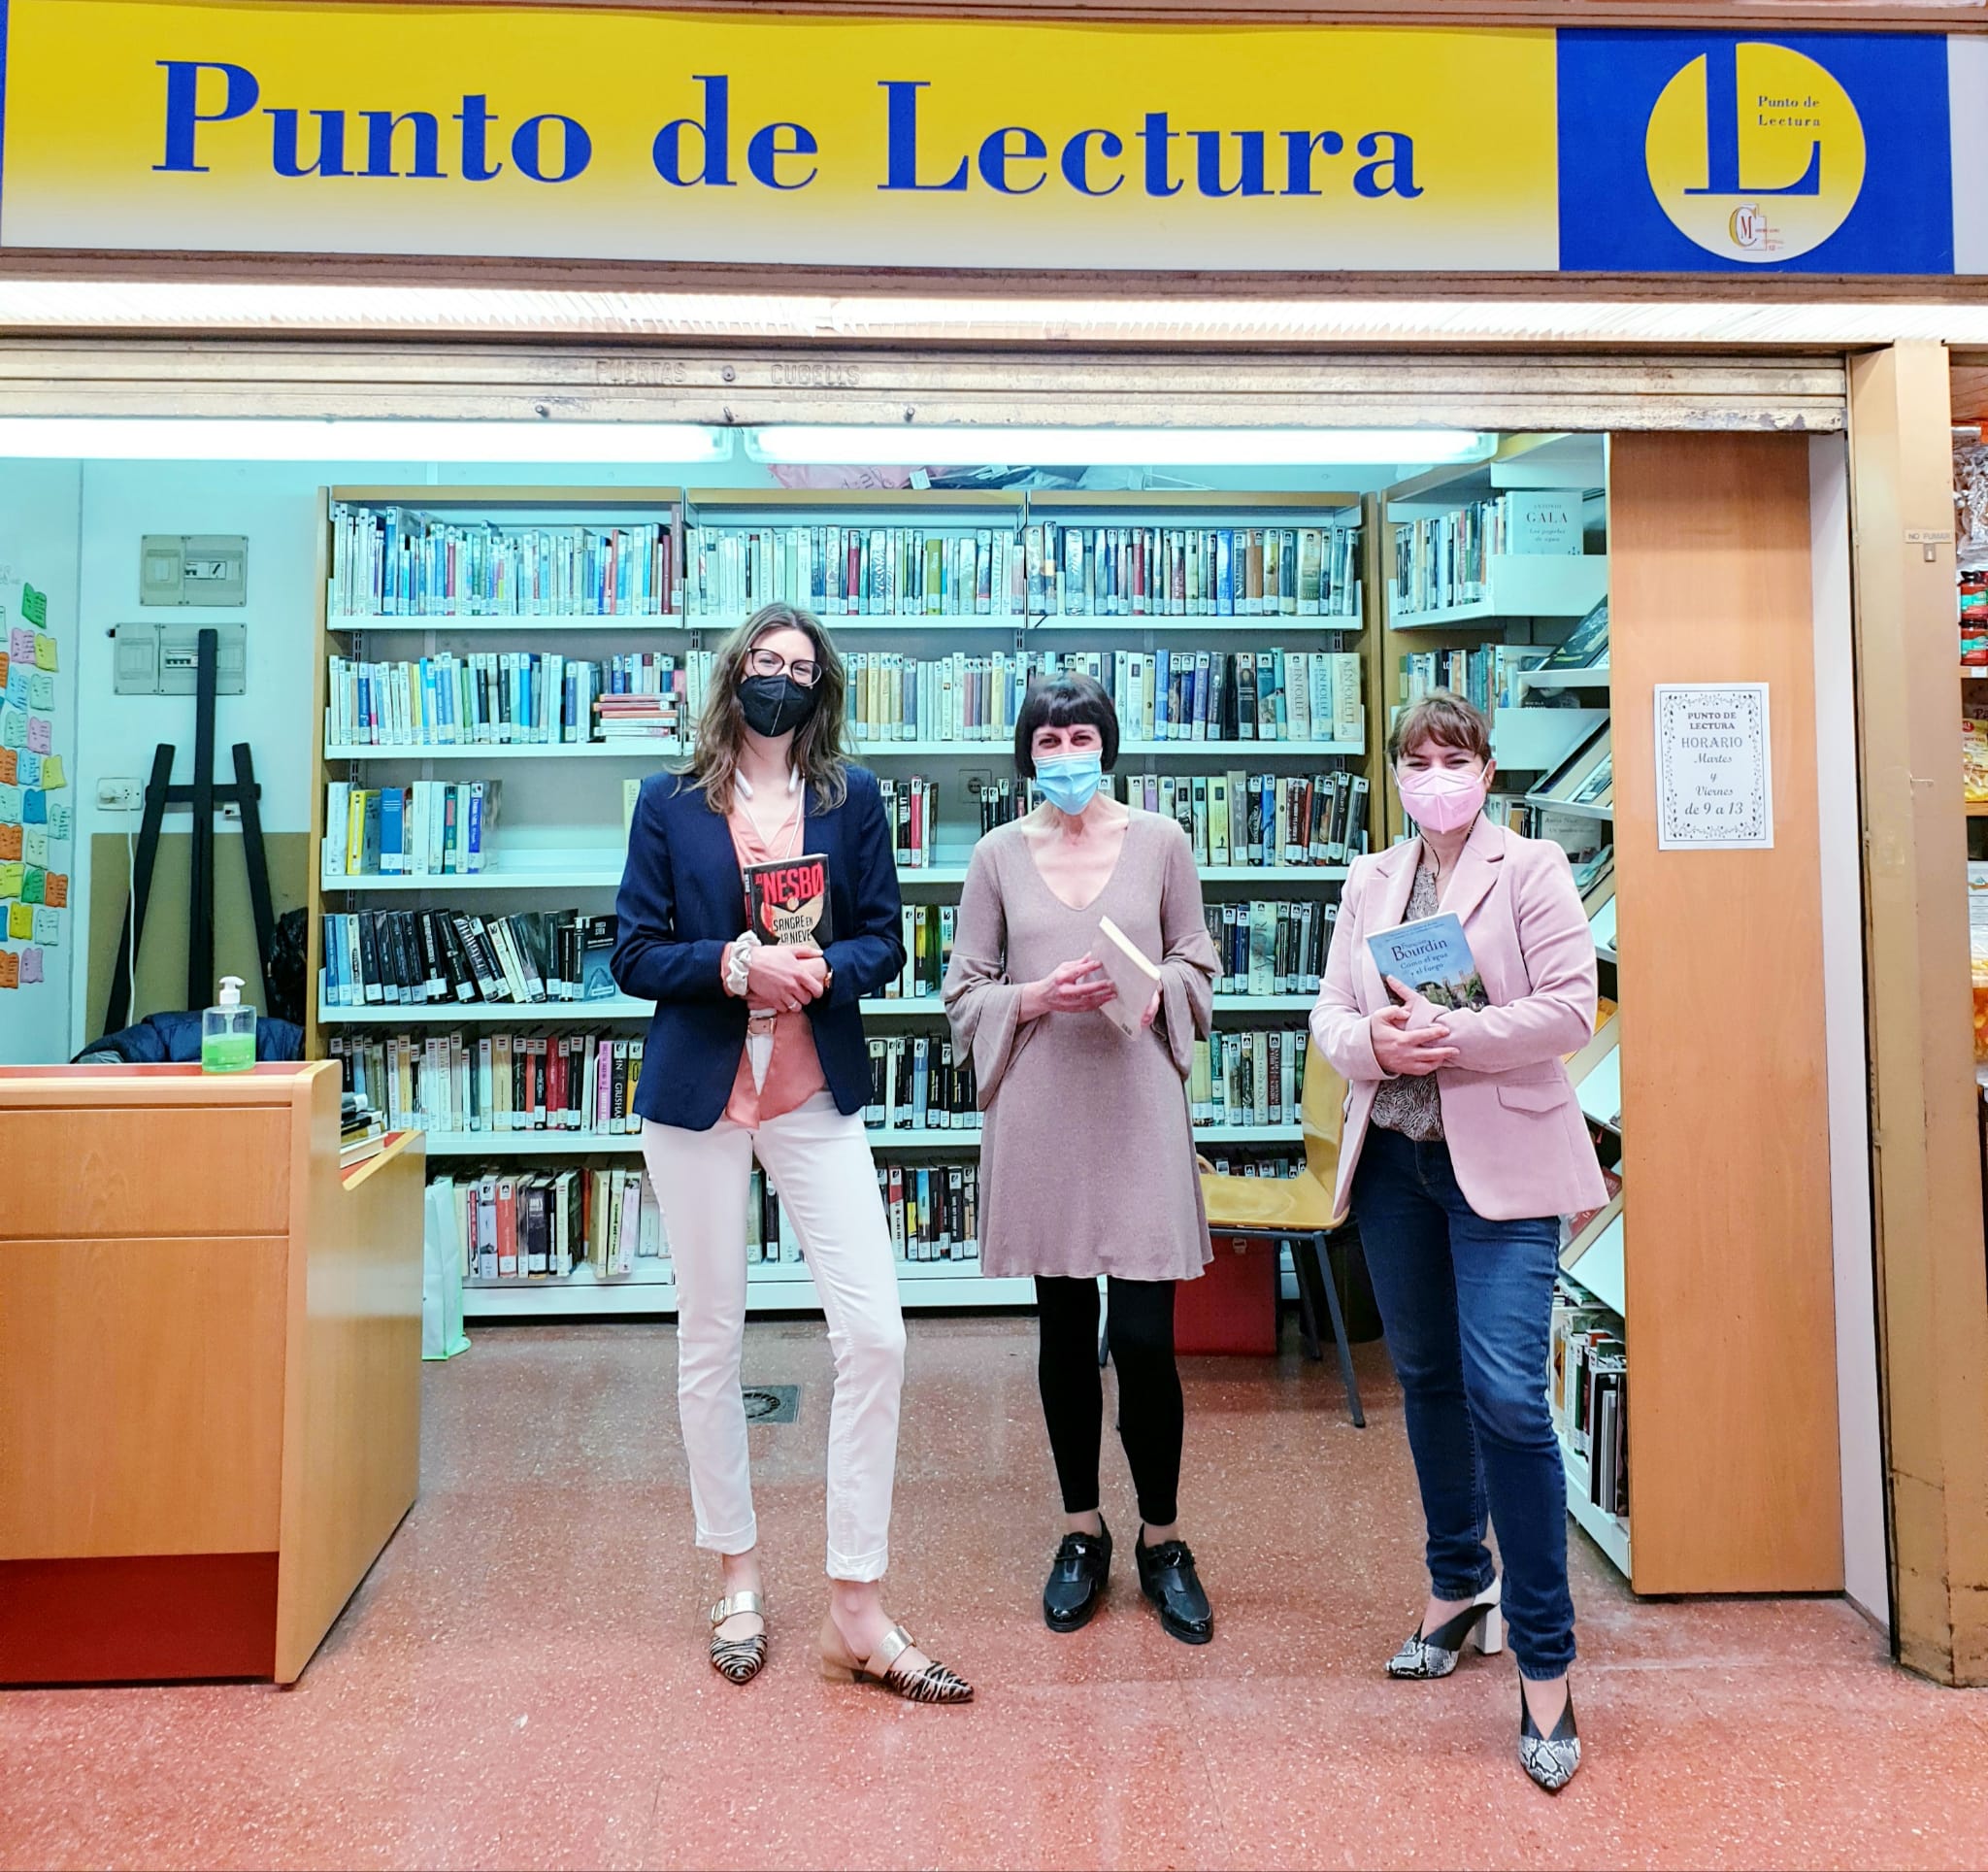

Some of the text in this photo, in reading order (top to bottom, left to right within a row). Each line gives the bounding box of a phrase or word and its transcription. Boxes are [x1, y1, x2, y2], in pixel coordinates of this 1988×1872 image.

[1758, 95, 1821, 108] Punto de
[1758, 115, 1821, 127] Lectura
[151, 59, 1425, 200] Punto de Lectura
[596, 360, 862, 385] PUERTAS CUBELLS
[1526, 512, 1568, 523] GALA
[1688, 712, 1721, 720] PUNTO
[1690, 721, 1736, 730] LECTURA
[1681, 737, 1742, 749] HORARIO
[1694, 752, 1733, 763] Martes
[1710, 772, 1717, 783] y
[1696, 785, 1734, 796] Viernes
[1684, 801, 1743, 816] de 9 a 13
[763, 862, 825, 903] NESBØ
[774, 915, 805, 932] SANGRE
[780, 929, 812, 945] LA NIEVE
[1391, 939, 1448, 962] Bourdin
[1401, 959, 1423, 969] Como
